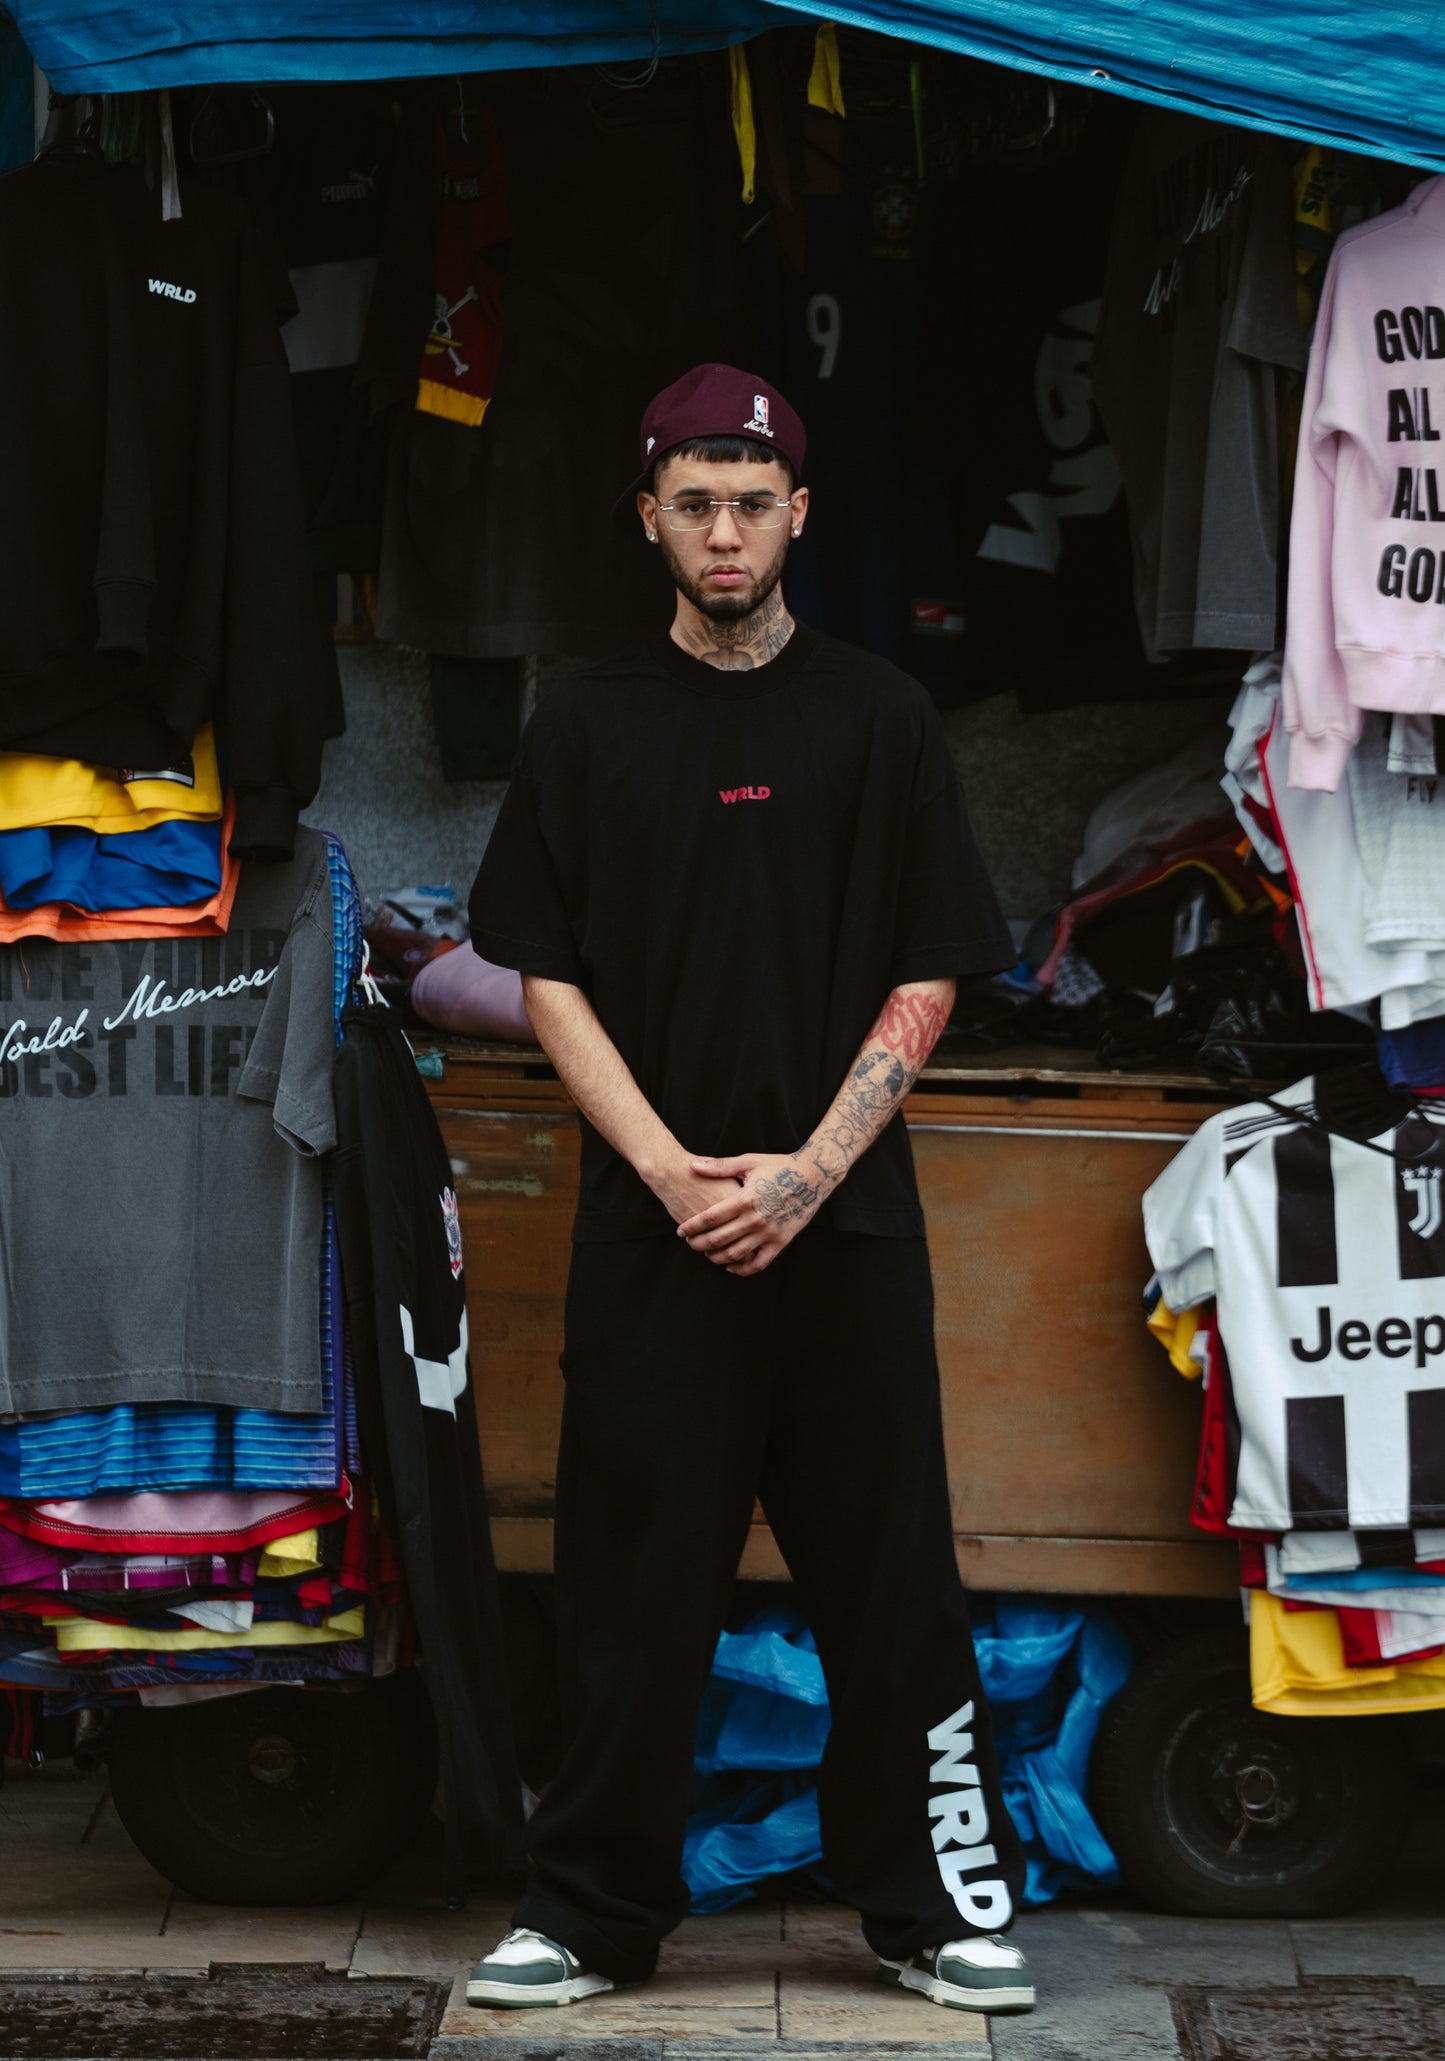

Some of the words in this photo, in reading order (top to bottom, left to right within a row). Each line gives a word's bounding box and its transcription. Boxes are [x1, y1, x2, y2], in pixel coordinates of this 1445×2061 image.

[148, 278, 197, 303] WRLD
[807, 293, 841, 379] 9
[1373, 305, 1445, 364] GOD
[1387, 387, 1440, 442] AL
[1390, 466, 1445, 522] ALL
[719, 785, 771, 804] WRLD
[0, 936, 94, 1001] IVE
[103, 965, 279, 1030] Memor
[155, 1025, 258, 1097] LIF
[1290, 1306, 1445, 1369] Jeep
[927, 1699, 1013, 1930] WRLD
